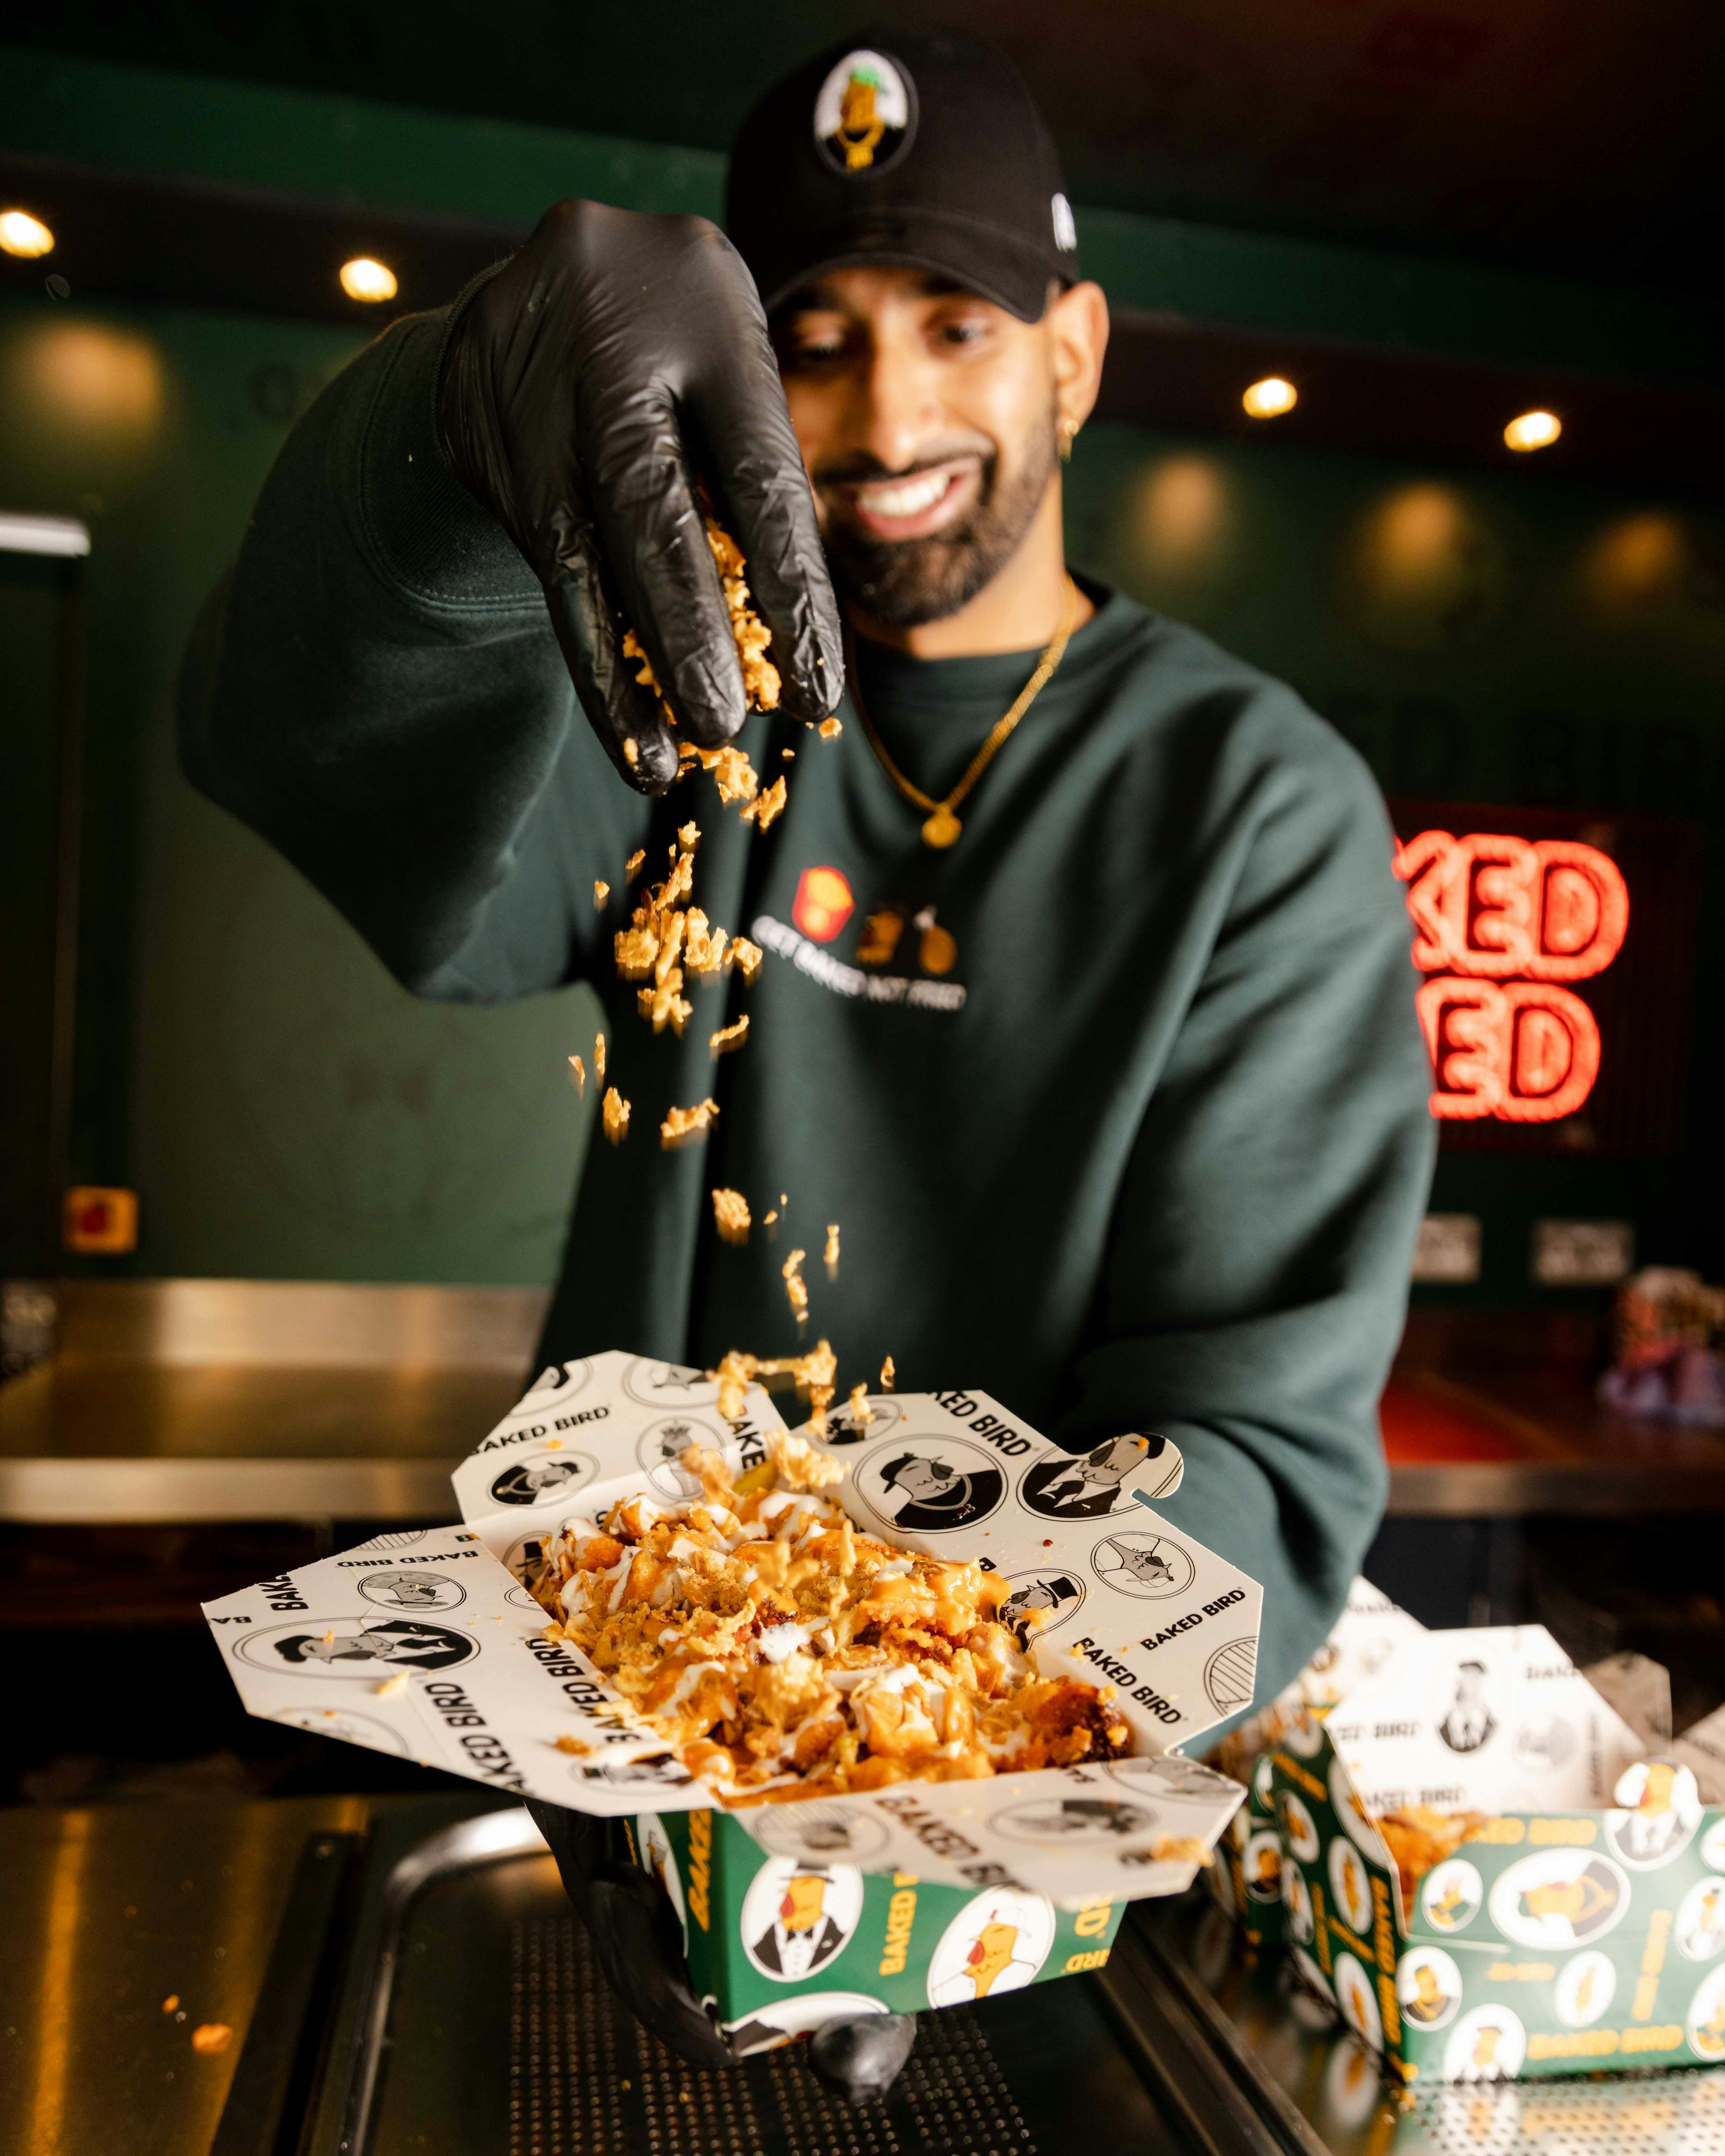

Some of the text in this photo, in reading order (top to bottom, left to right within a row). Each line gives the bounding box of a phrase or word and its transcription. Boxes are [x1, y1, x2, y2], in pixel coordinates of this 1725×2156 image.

[473, 1407, 610, 1454] AKED BIRD
[969, 1414, 1031, 1456] BIRD
[337, 1550, 479, 1568] BAKED BIRD
[1140, 1590, 1246, 1651] BAKED BIRD
[525, 1638, 585, 1677] BIRD
[1072, 1637, 1181, 1724] BAKED BIRD
[424, 1683, 486, 1727] BIRD
[879, 1890, 917, 1976] BAKED
